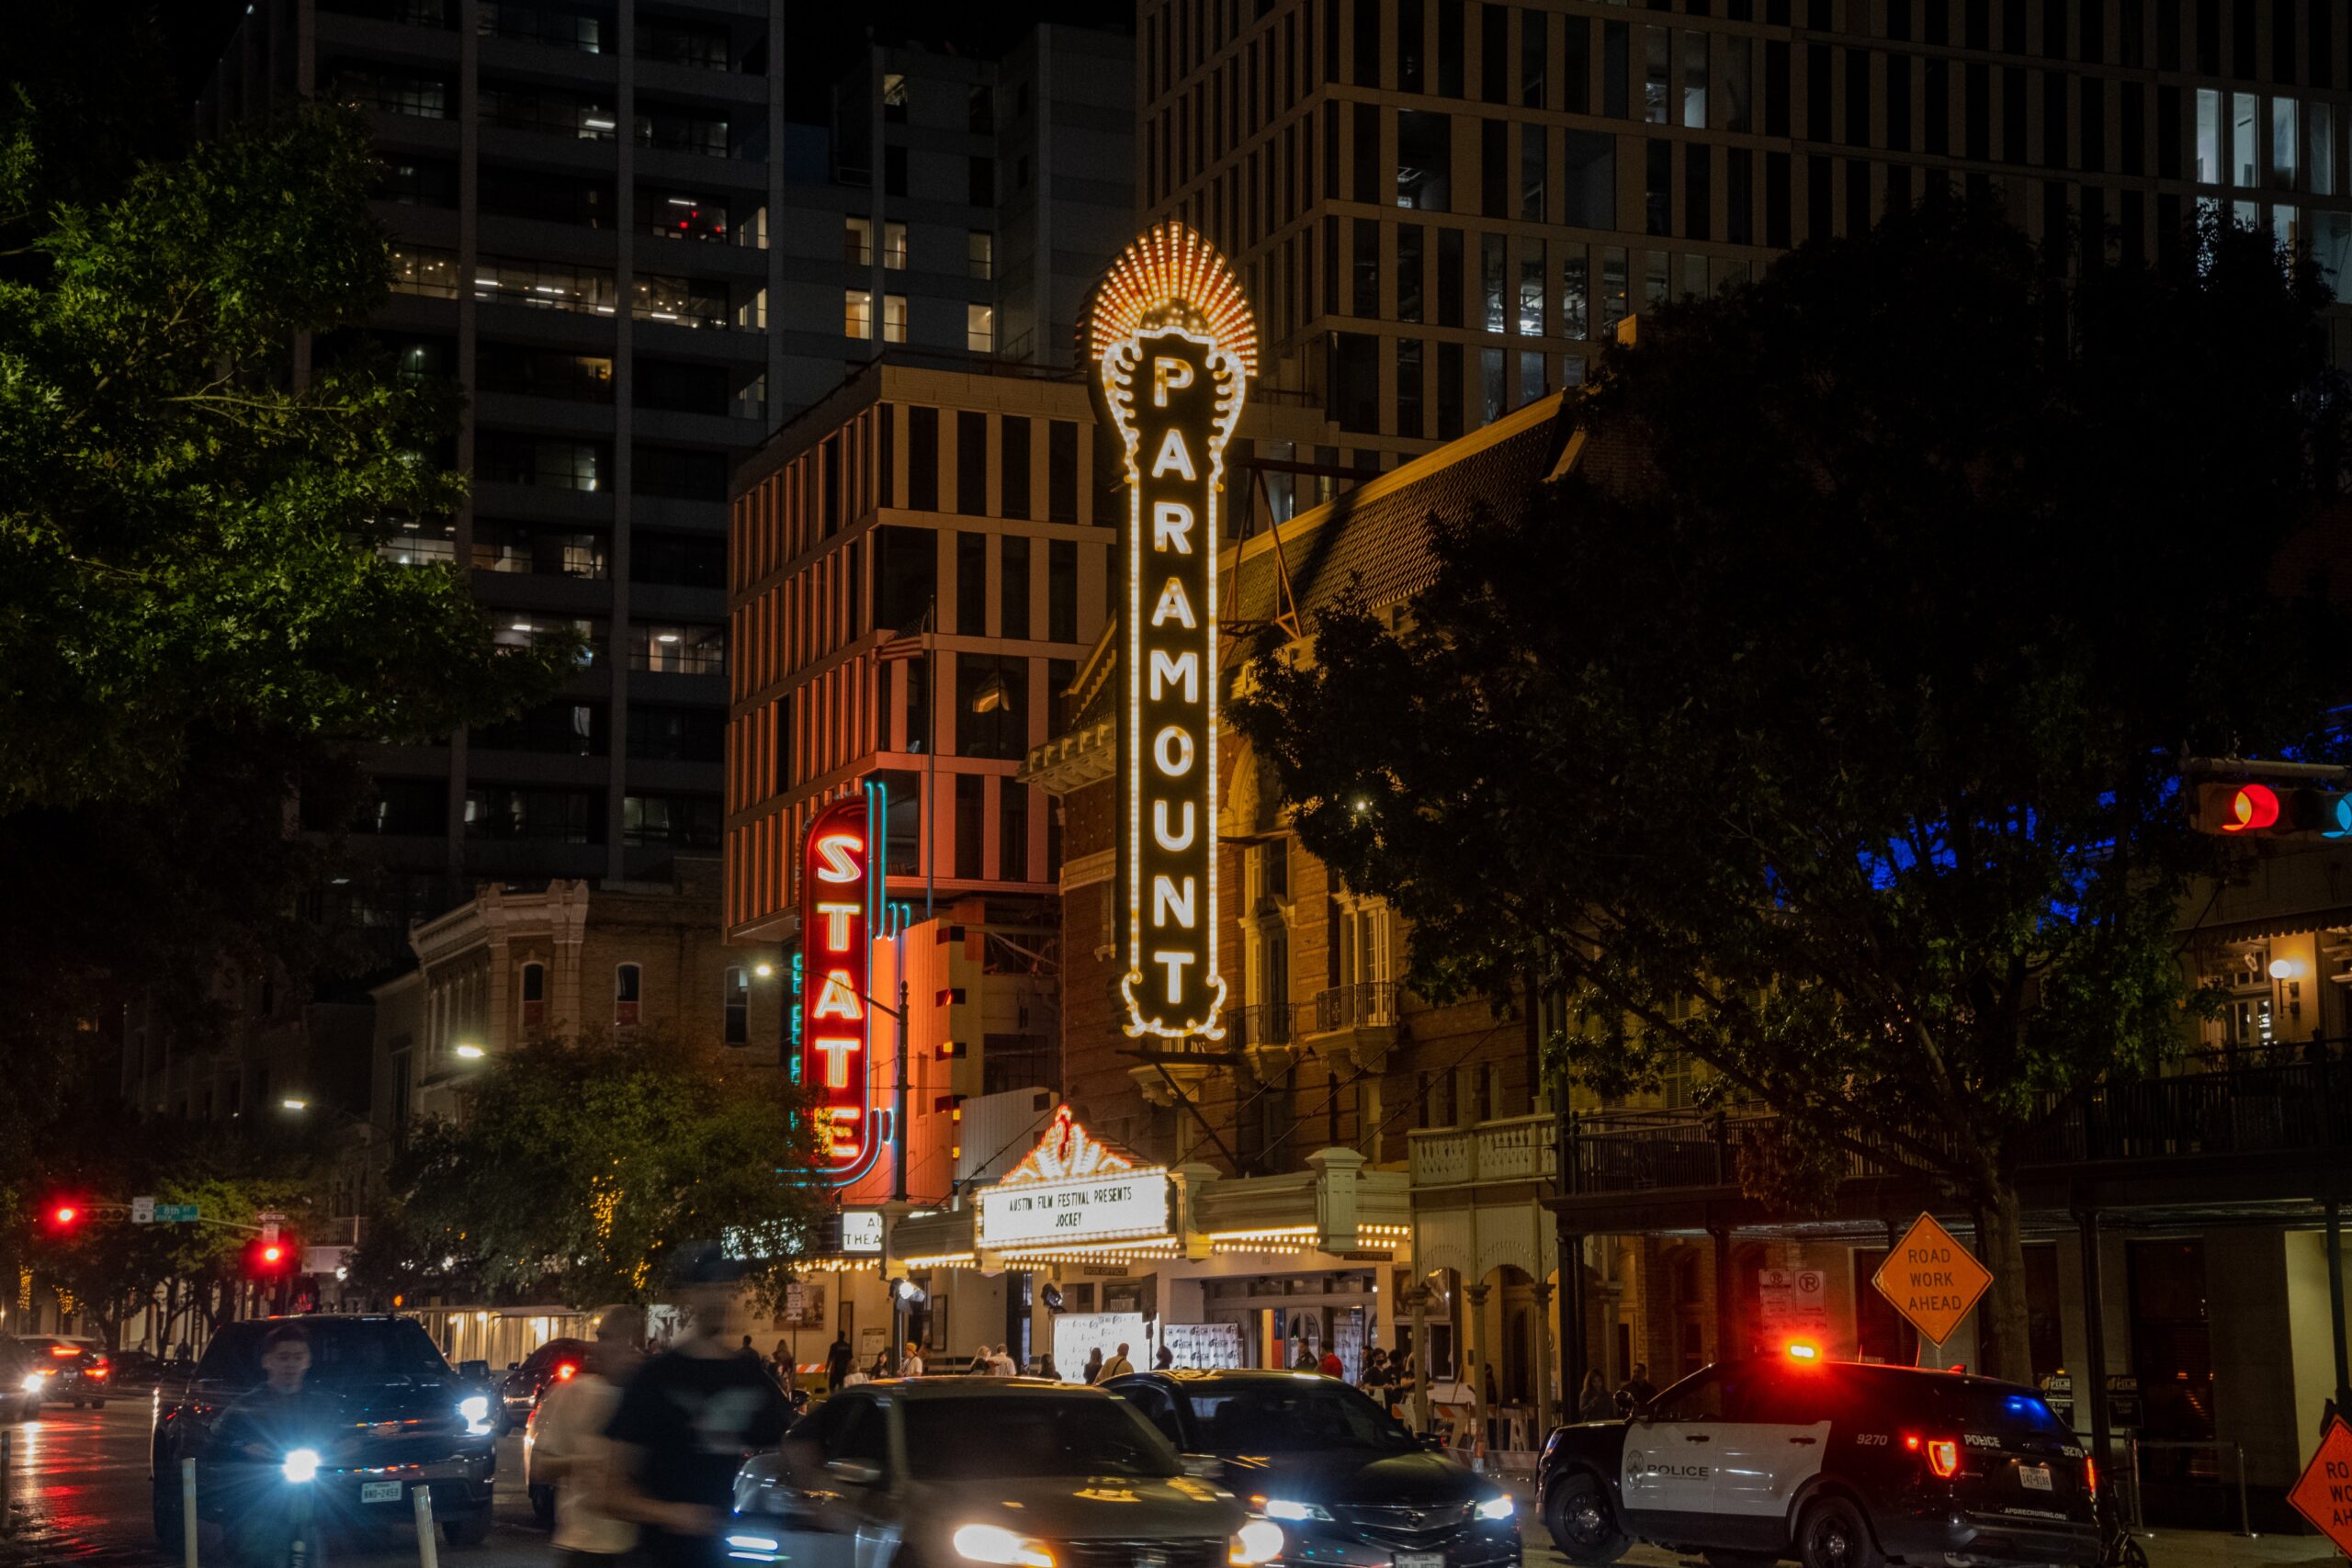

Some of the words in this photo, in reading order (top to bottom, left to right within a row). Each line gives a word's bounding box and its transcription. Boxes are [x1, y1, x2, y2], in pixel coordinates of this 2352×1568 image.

[1150, 356, 1197, 1003] PARAMOUNT
[813, 836, 863, 1156] STATE
[1009, 1197, 1033, 1212] AUSTIN
[1037, 1195, 1053, 1210] FILM
[1057, 1190, 1090, 1207] FESTIVAL
[1094, 1186, 1132, 1203] PRESENTS
[163, 1204, 179, 1215] 8th
[1056, 1212, 1082, 1227] JOCKEY
[1908, 1248, 1951, 1263] ROAD
[1910, 1272, 1953, 1286] WORK
[1908, 1295, 1962, 1311] AHEAD
[1856, 1434, 1888, 1446] 9270
[1963, 1434, 2001, 1448] POLICE
[2061, 1445, 2084, 1458] 9270
[1647, 1464, 1709, 1477] POLICE
[2325, 1461, 2349, 1479] RO
[2004, 1507, 2067, 1520] APDRECRUITING.ORG
